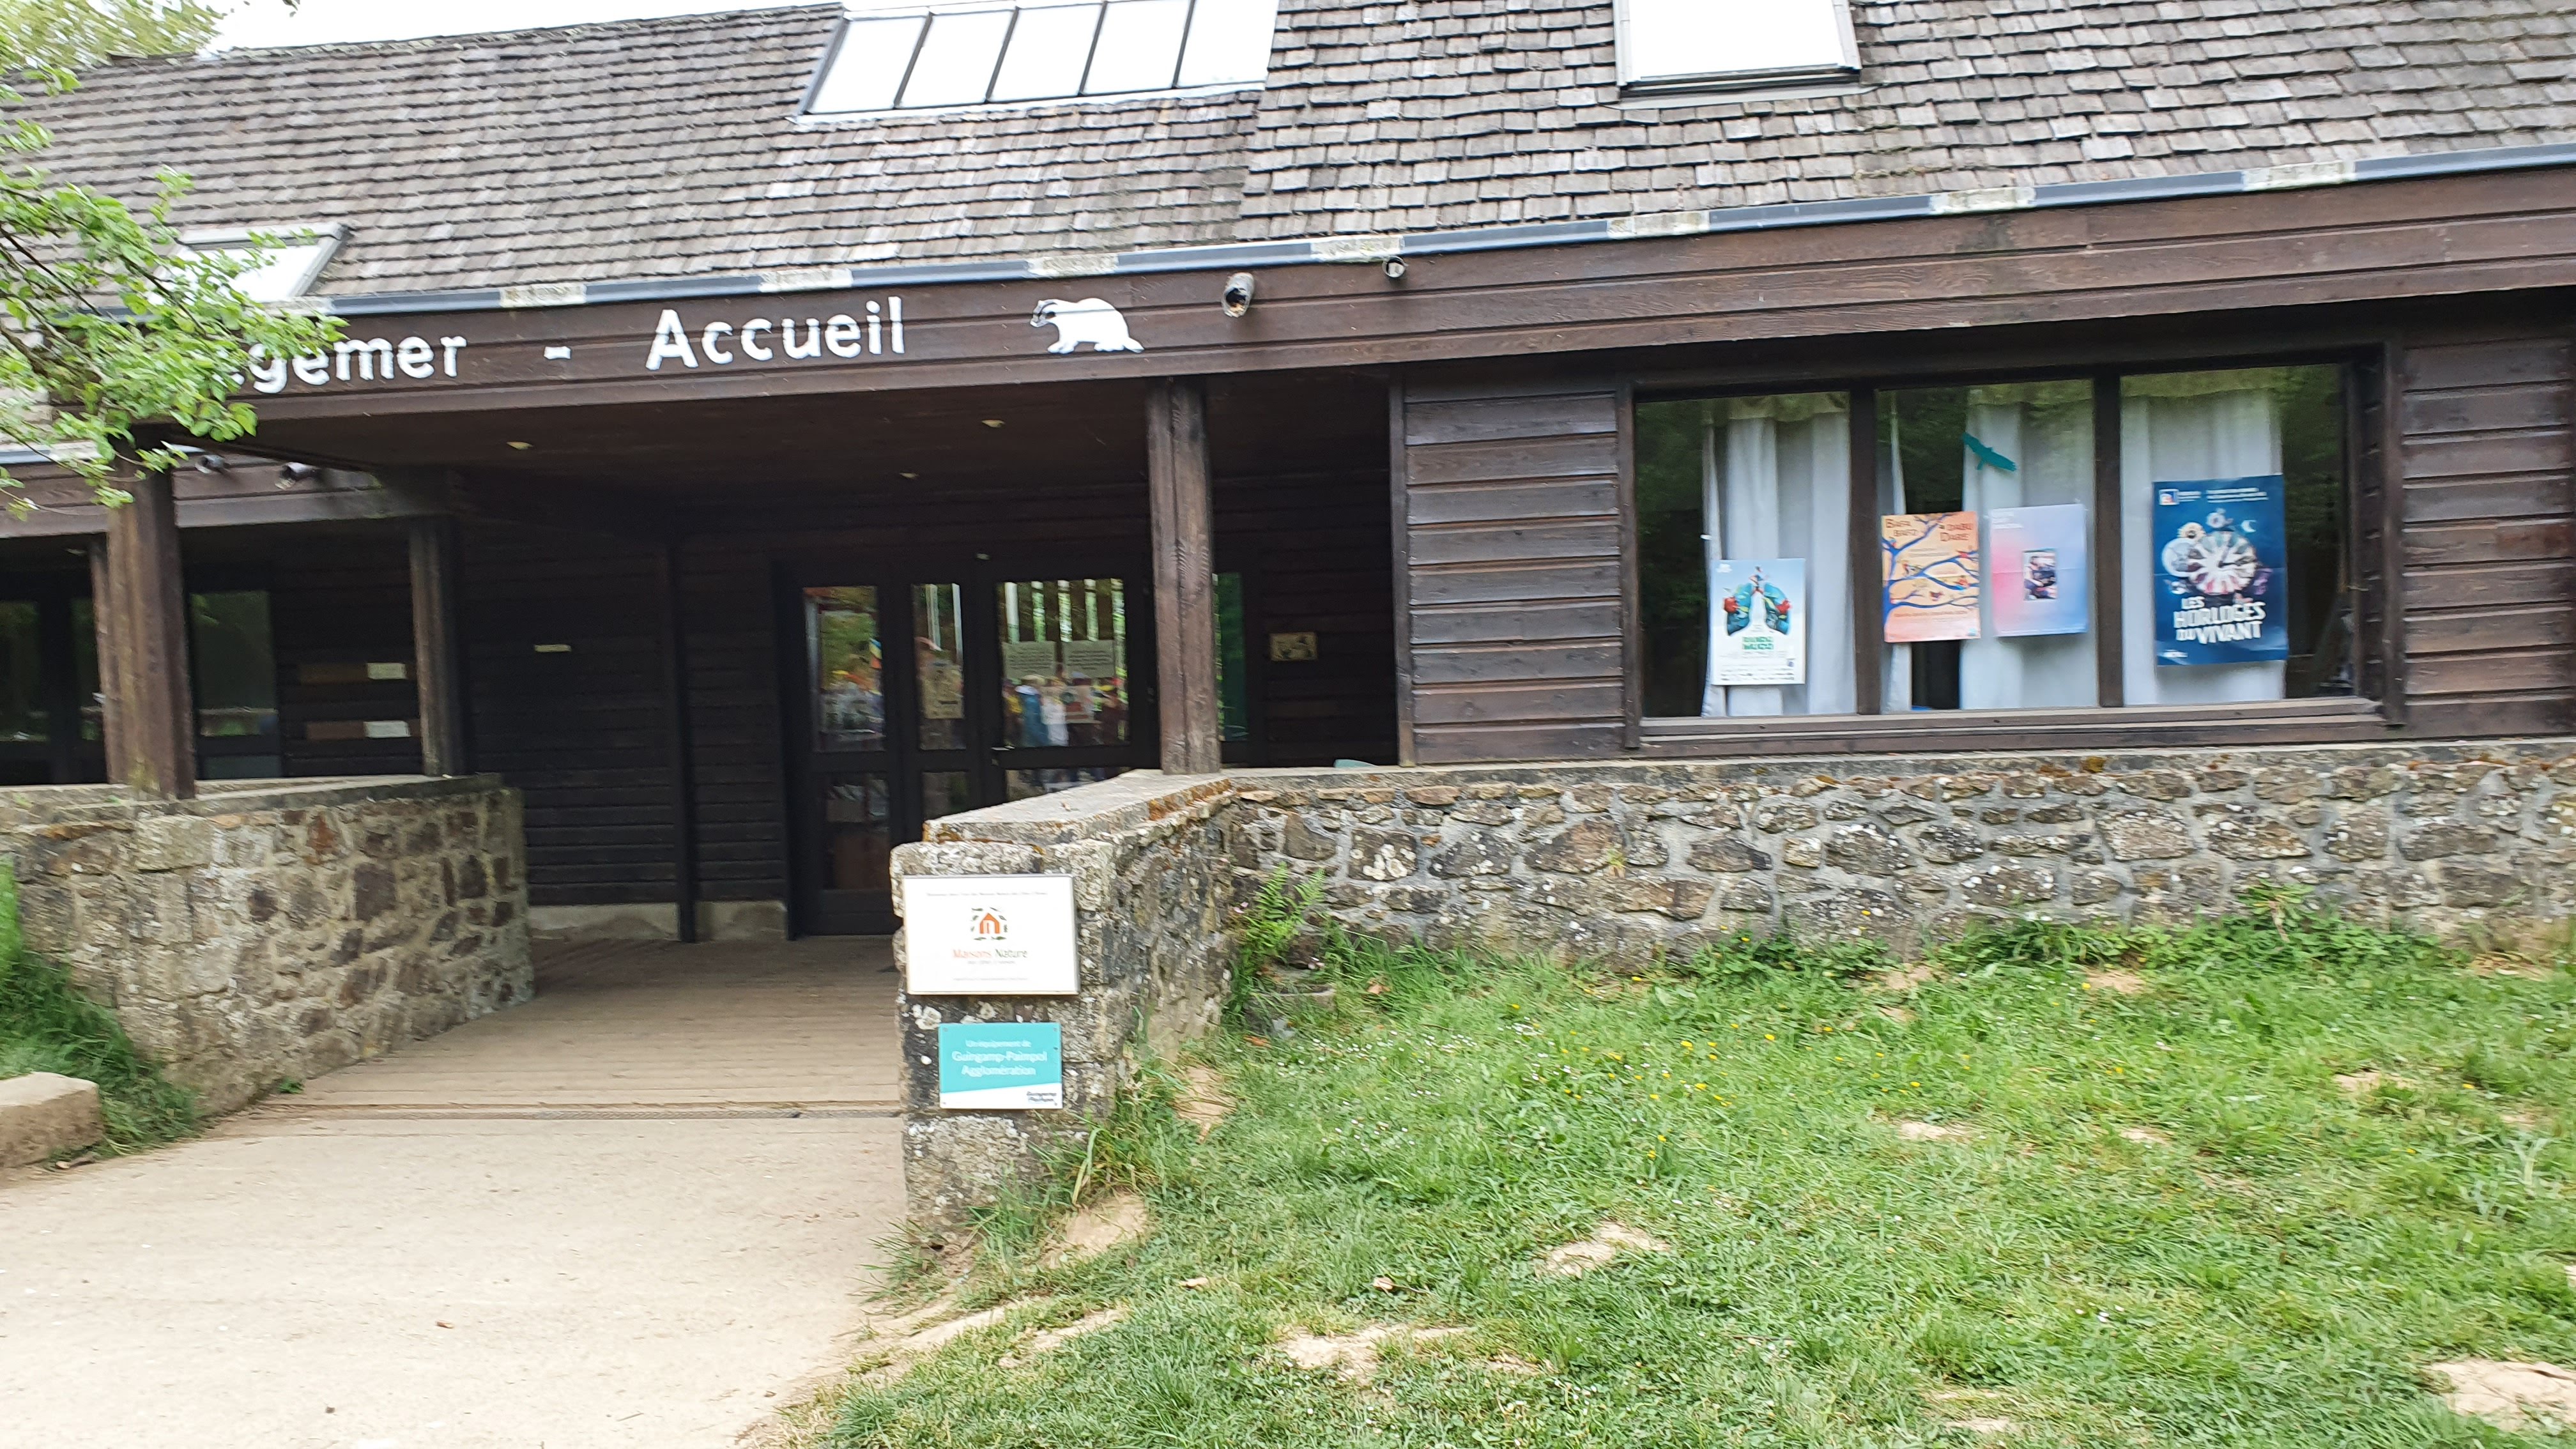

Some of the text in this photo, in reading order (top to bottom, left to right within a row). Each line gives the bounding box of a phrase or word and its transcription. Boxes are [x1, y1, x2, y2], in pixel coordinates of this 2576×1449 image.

[231, 335, 467, 394] gemer
[645, 296, 905, 371] Accueil
[2181, 596, 2205, 609] LES
[2174, 601, 2266, 628] HORLOGES
[2195, 620, 2263, 645] VIVANT
[995, 948, 1028, 959] Nature
[951, 1050, 1048, 1063] Guingamp-Paimpol
